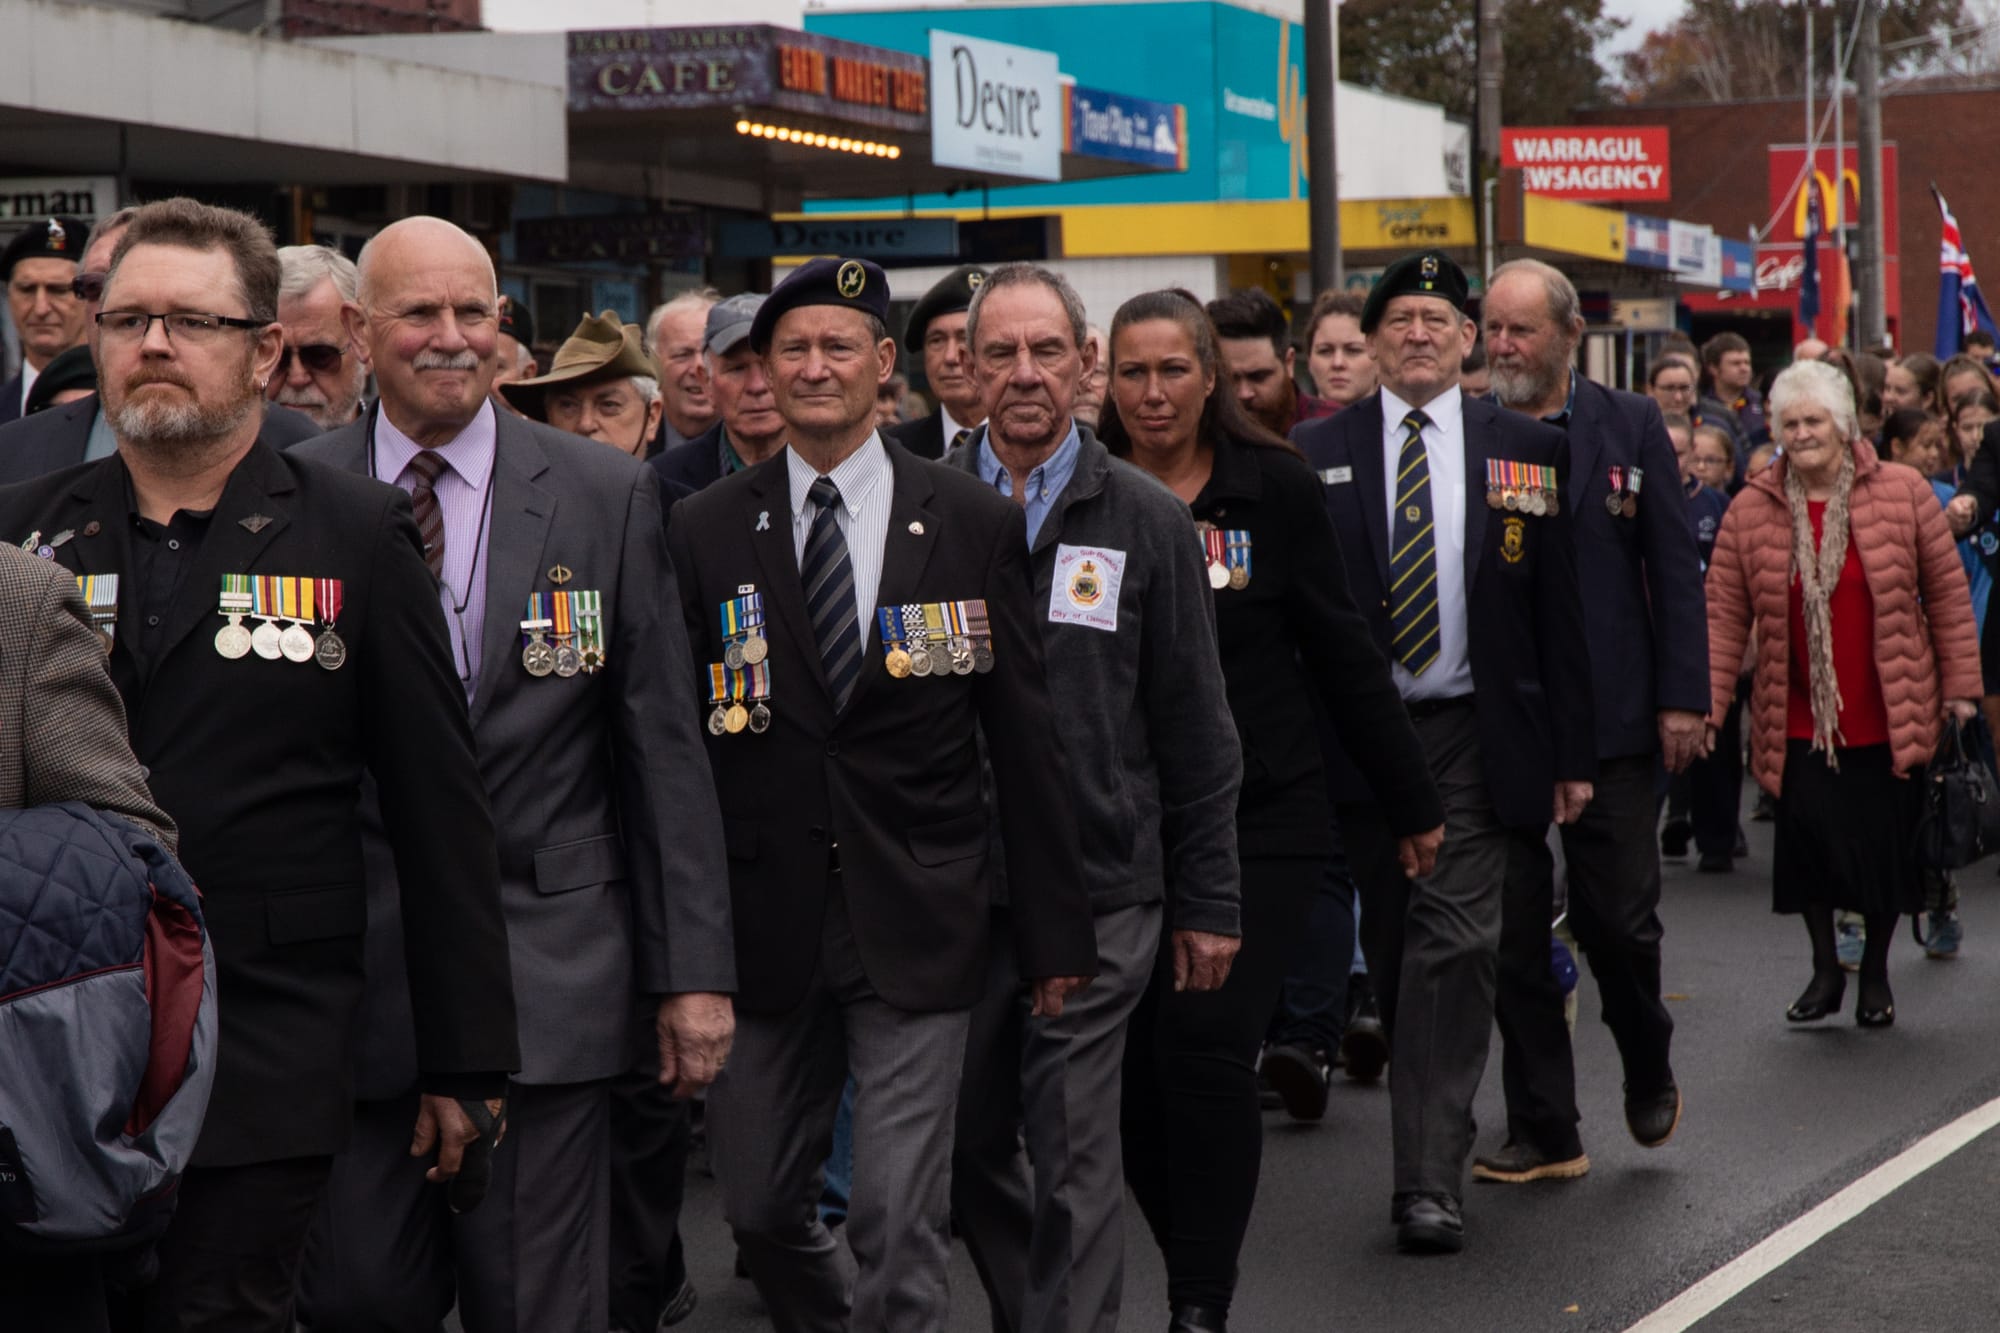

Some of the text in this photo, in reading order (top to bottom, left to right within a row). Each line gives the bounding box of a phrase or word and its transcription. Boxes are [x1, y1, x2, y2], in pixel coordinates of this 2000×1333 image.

[597, 60, 737, 96] CAFE
[951, 45, 1041, 139] Desire
[1512, 137, 1648, 162] WARRAGUL
[1523, 166, 1662, 190] WSAGENCY
[771, 221, 905, 248] Desire
[1390, 223, 1450, 240] OPTUS
[1052, 610, 1067, 619] City
